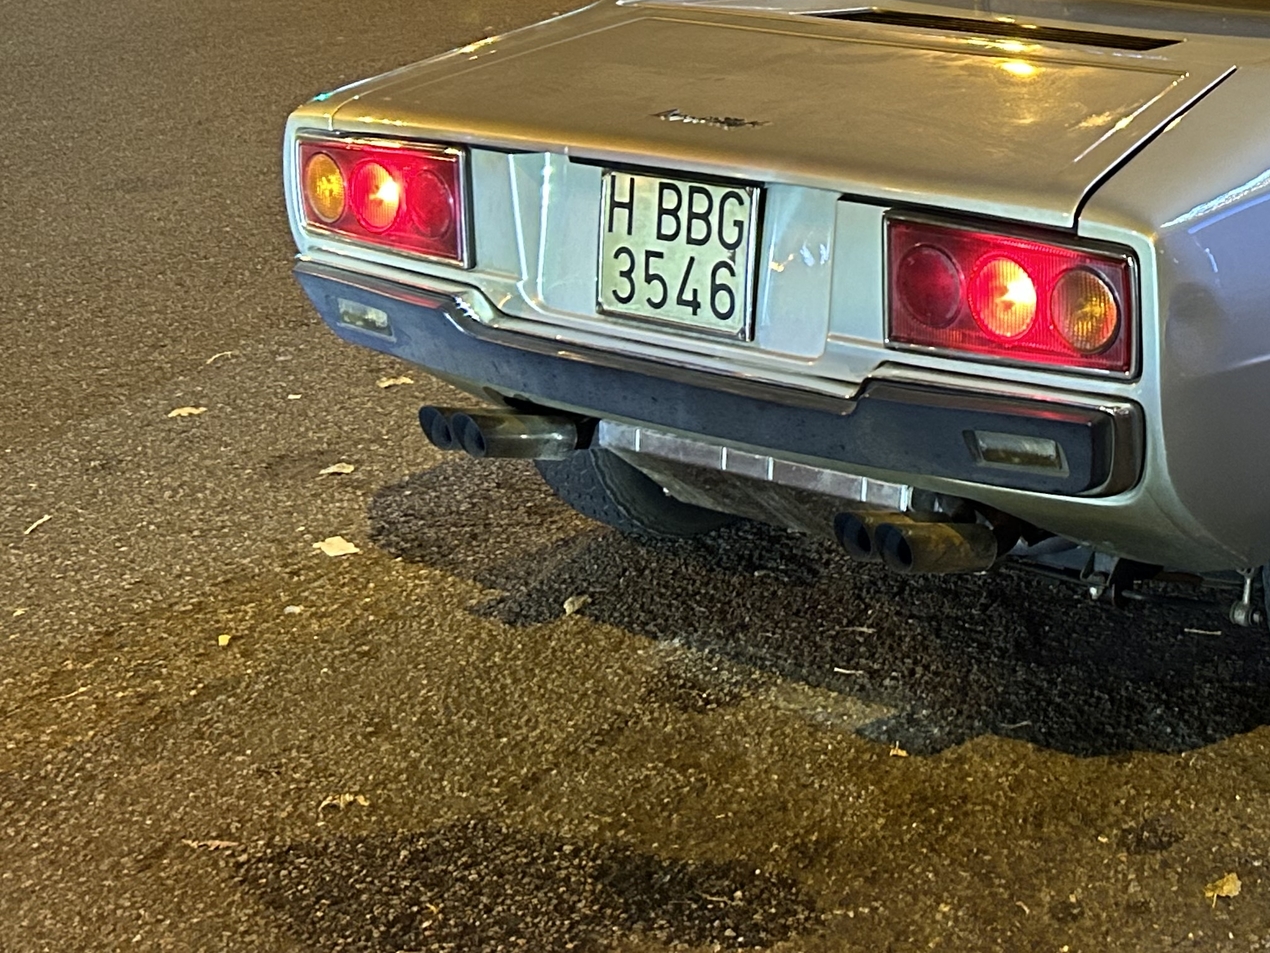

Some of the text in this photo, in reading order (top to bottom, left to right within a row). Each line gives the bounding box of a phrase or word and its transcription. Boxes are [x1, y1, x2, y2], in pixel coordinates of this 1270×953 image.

[608, 174, 745, 251] H BBG
[611, 246, 737, 321] 3546
